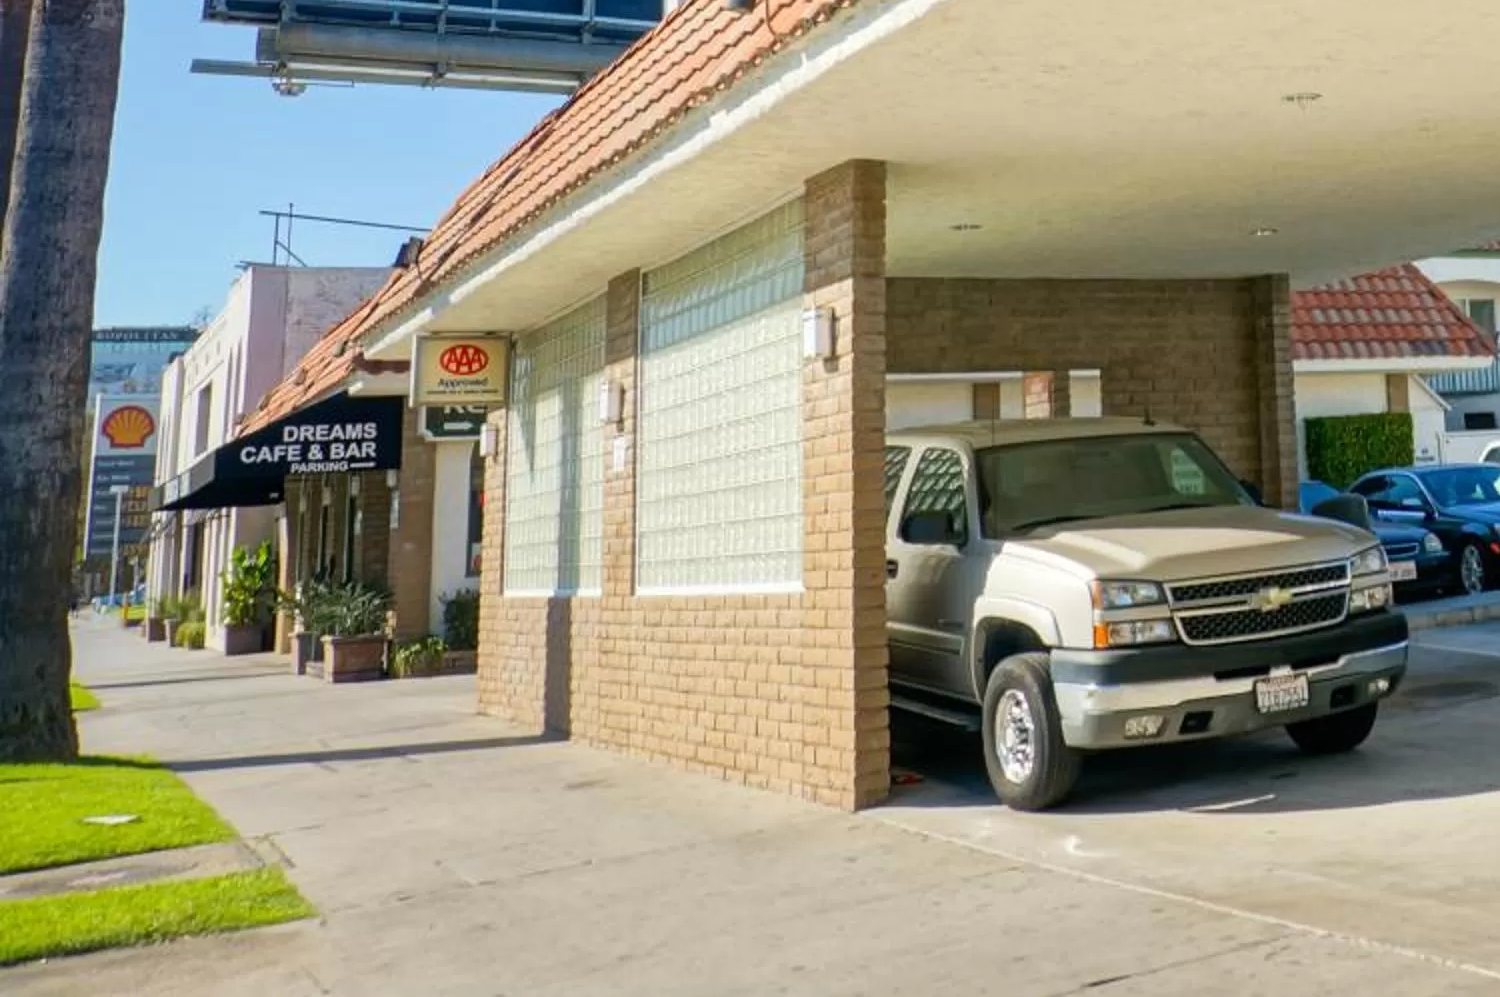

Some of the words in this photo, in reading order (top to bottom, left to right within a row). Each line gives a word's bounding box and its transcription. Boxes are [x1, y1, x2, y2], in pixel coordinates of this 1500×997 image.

[440, 345, 488, 374] AAA
[283, 422, 377, 442] DREAMS
[241, 445, 302, 463] CAFE
[308, 443, 323, 460] &
[330, 441, 376, 460] BAR
[290, 461, 348, 473] PARKING
